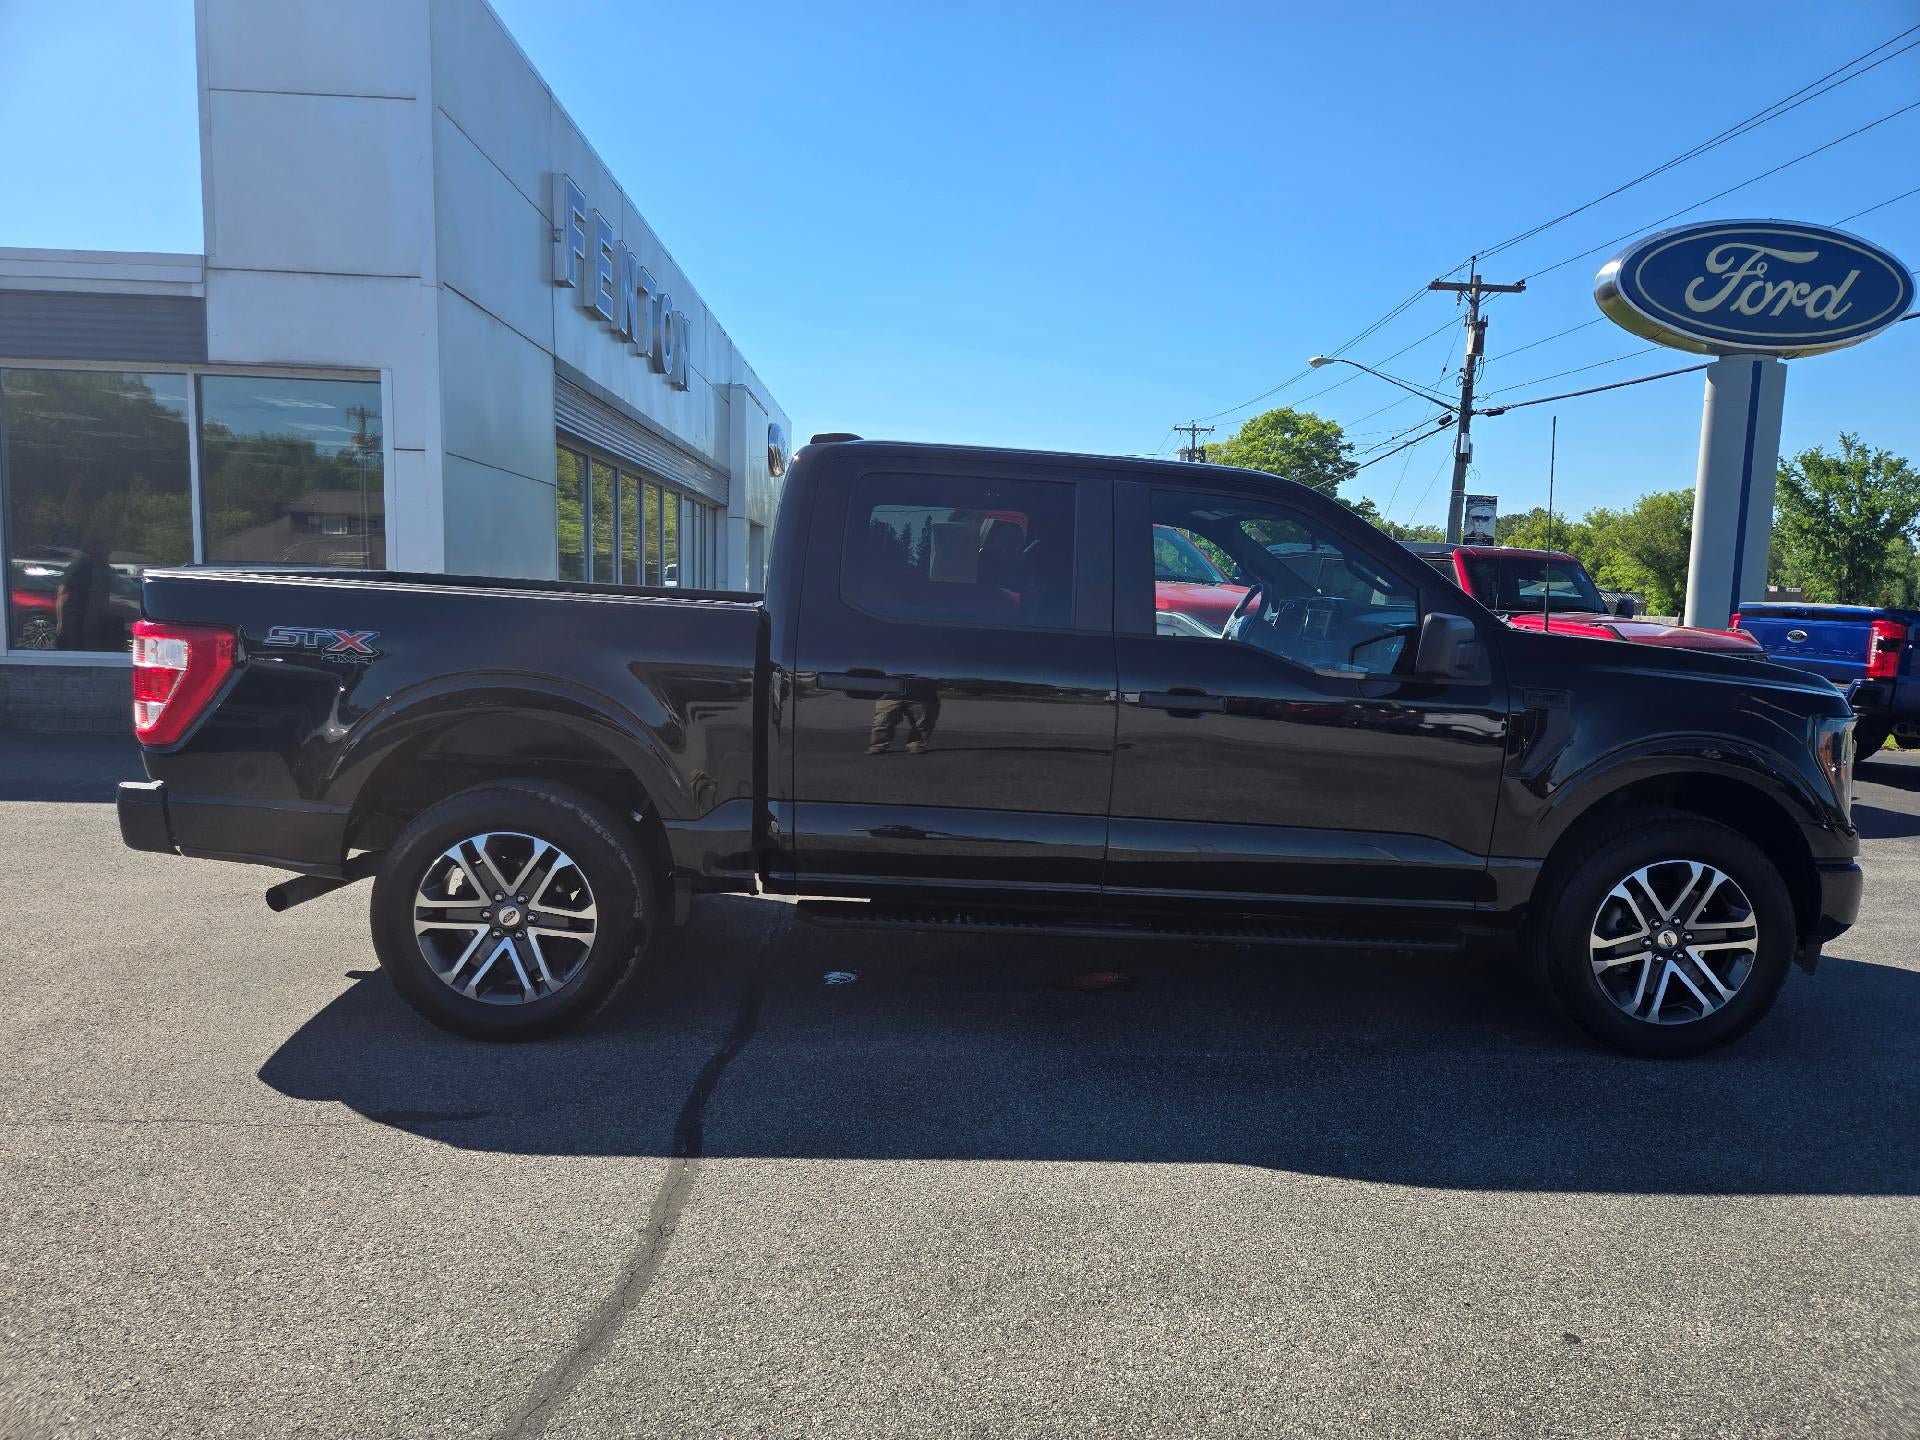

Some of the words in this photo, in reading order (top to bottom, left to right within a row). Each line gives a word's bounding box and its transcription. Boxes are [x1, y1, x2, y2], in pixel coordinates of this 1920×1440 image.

[553, 173, 690, 392] FENTON
[1684, 242, 1861, 322] Ford
[263, 625, 381, 655] STX
